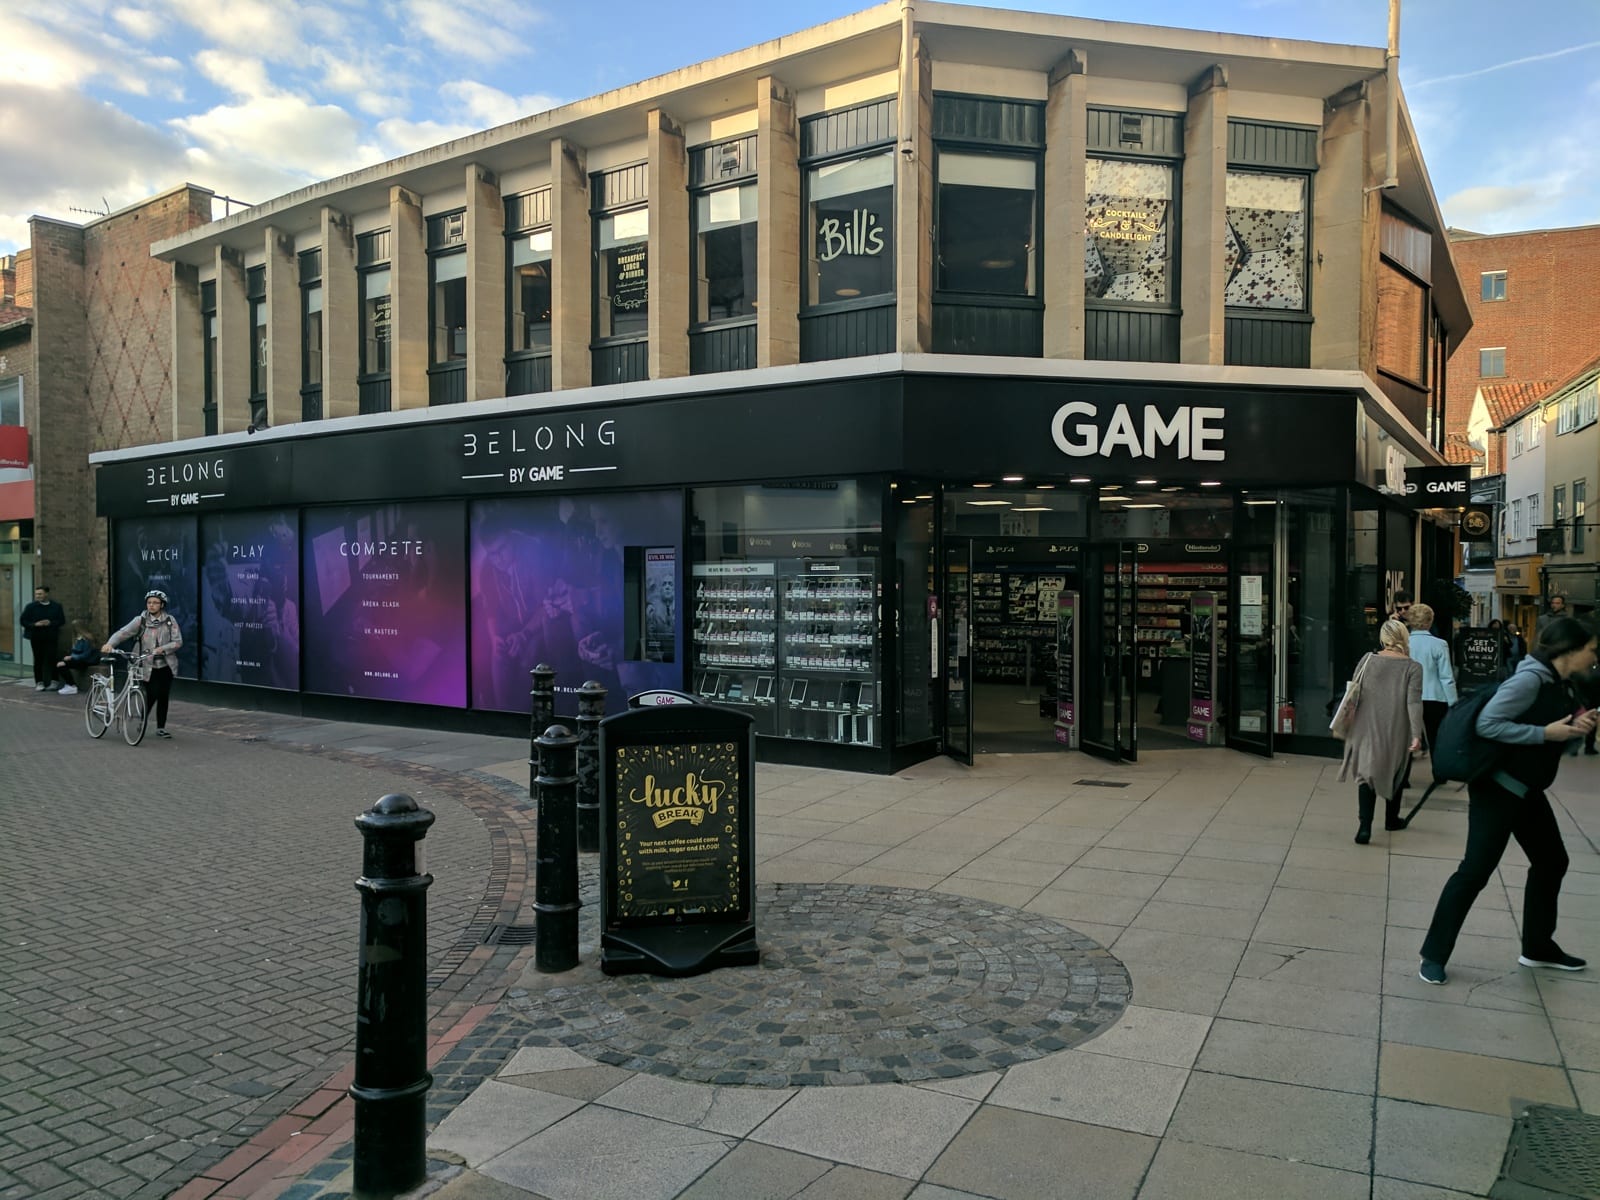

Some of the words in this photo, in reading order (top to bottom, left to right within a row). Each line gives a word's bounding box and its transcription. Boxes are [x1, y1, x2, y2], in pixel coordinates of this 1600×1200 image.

[1105, 209, 1147, 219] COCKTAILS
[1120, 219, 1132, 231] &
[819, 208, 884, 262] Bill's
[1100, 231, 1152, 241] CANDLELIGHT
[617, 252, 645, 265] BREAKFAST
[623, 262, 640, 271] LUNCH
[625, 268, 645, 279] DINNER
[1051, 401, 1225, 461] GAME
[463, 420, 615, 456] BELONG
[146, 460, 224, 486] BELONG
[509, 468, 525, 483] BY
[529, 465, 564, 482] GAME
[1426, 481, 1466, 493] GAME
[170, 494, 180, 506] BY
[180, 493, 199, 505] GAME
[141, 549, 178, 560] WATCH
[232, 545, 264, 558] PLAY
[340, 541, 423, 556] COMPETE
[656, 696, 675, 705] GAME
[1193, 705, 1210, 717] GAME
[1190, 726, 1204, 735] GAME
[630, 768, 725, 814] lucky
[658, 809, 699, 821] BREAK
[668, 837, 686, 845] coffee
